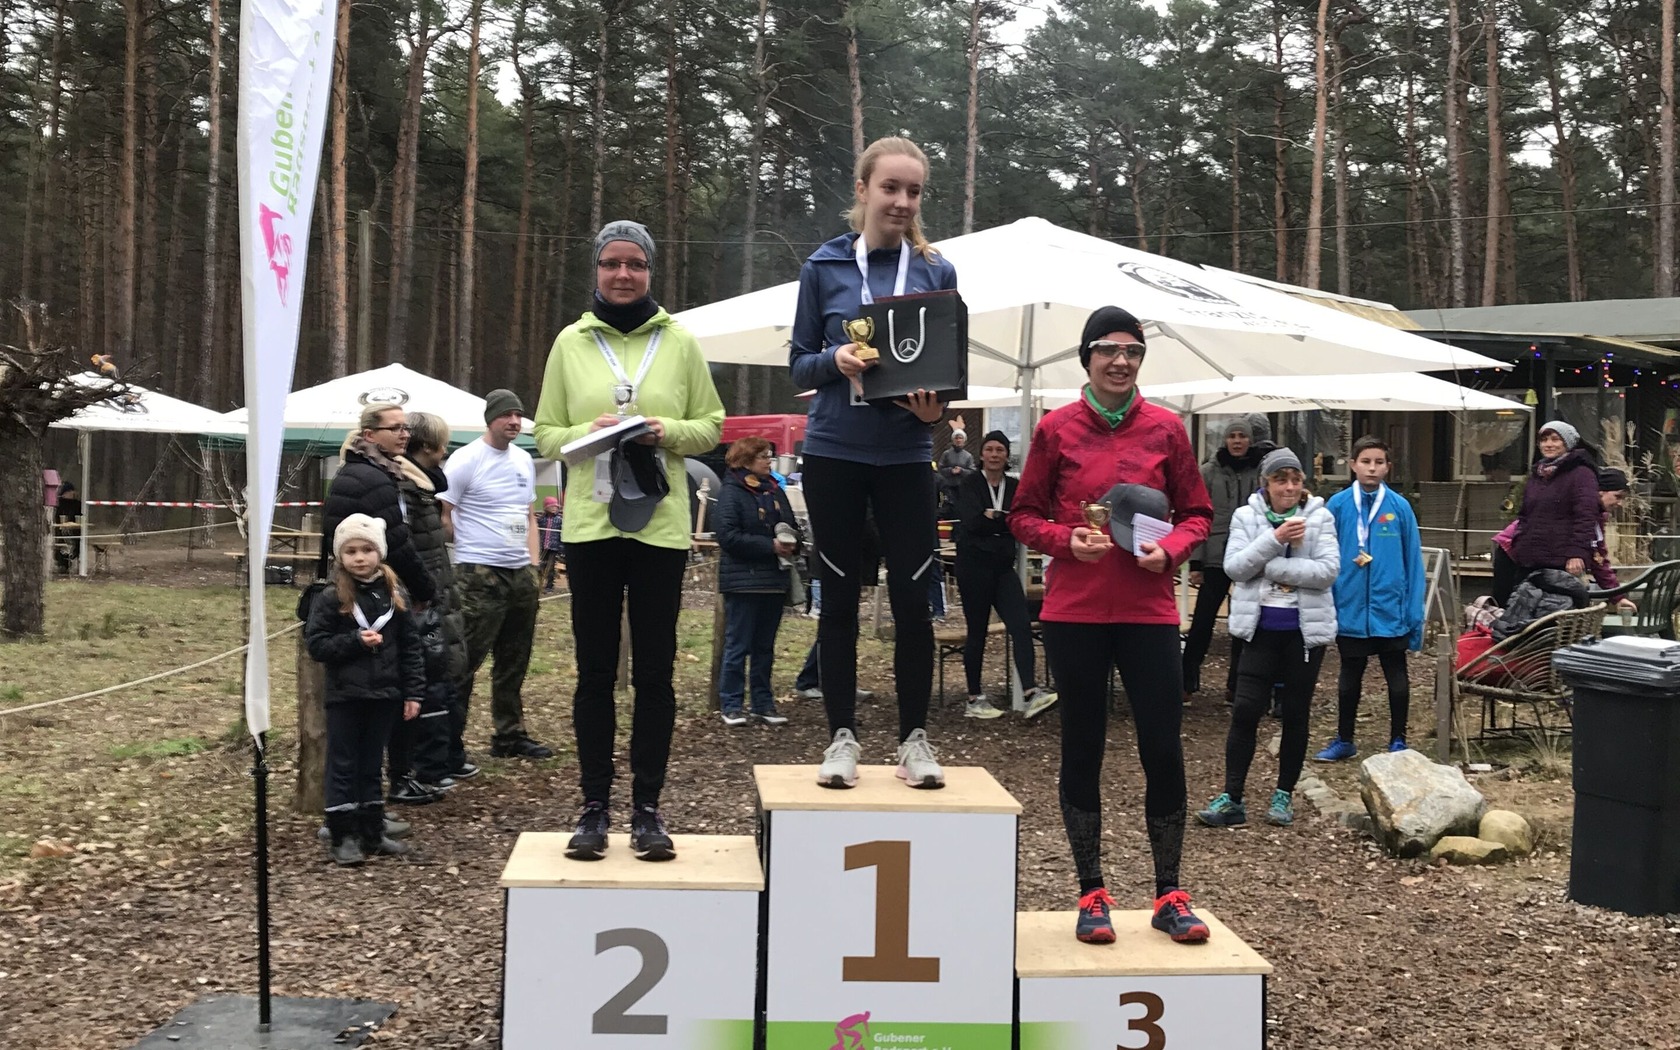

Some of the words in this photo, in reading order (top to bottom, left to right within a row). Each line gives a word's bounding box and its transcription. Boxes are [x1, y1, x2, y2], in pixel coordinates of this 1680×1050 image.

[842, 840, 940, 982] 1
[592, 927, 669, 1034] 2
[1116, 991, 1166, 1050] 3
[873, 1032, 926, 1043] Gubener
